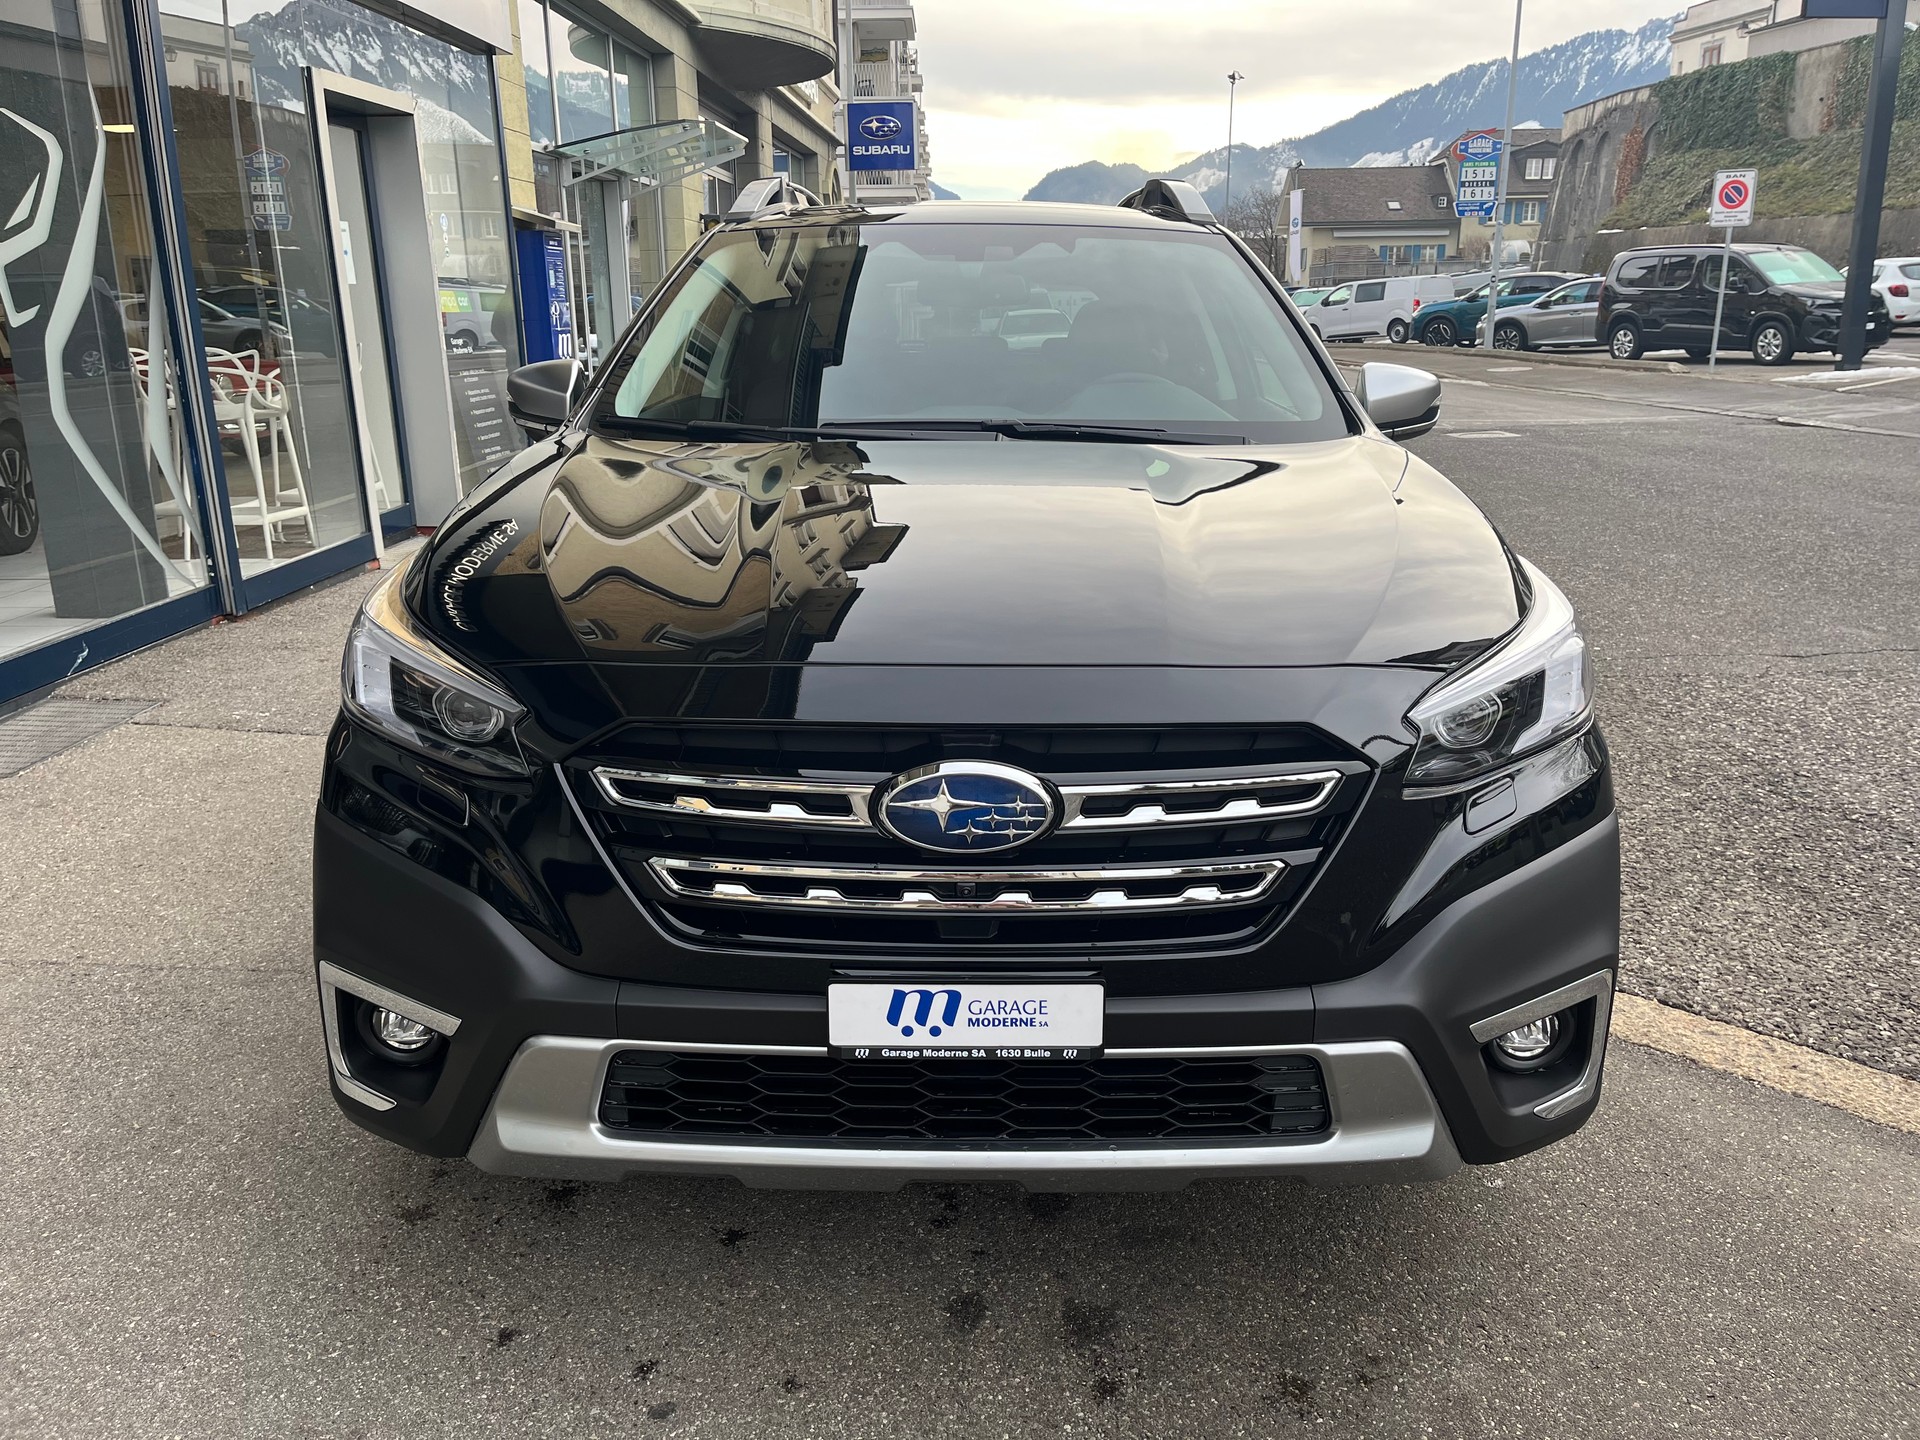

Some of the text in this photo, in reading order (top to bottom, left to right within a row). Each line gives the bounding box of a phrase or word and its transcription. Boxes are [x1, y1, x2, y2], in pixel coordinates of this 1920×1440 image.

[1468, 138, 1493, 147] GARAGE
[852, 144, 911, 156] SUBARU
[967, 999, 1049, 1016] GARAGE
[967, 1017, 1037, 1028] MODERNE
[881, 1048, 920, 1059] Garage
[922, 1048, 969, 1058] Moderne
[971, 1049, 987, 1058] SA
[995, 1049, 1021, 1058] 1630
[1023, 1048, 1051, 1058] Bulle
